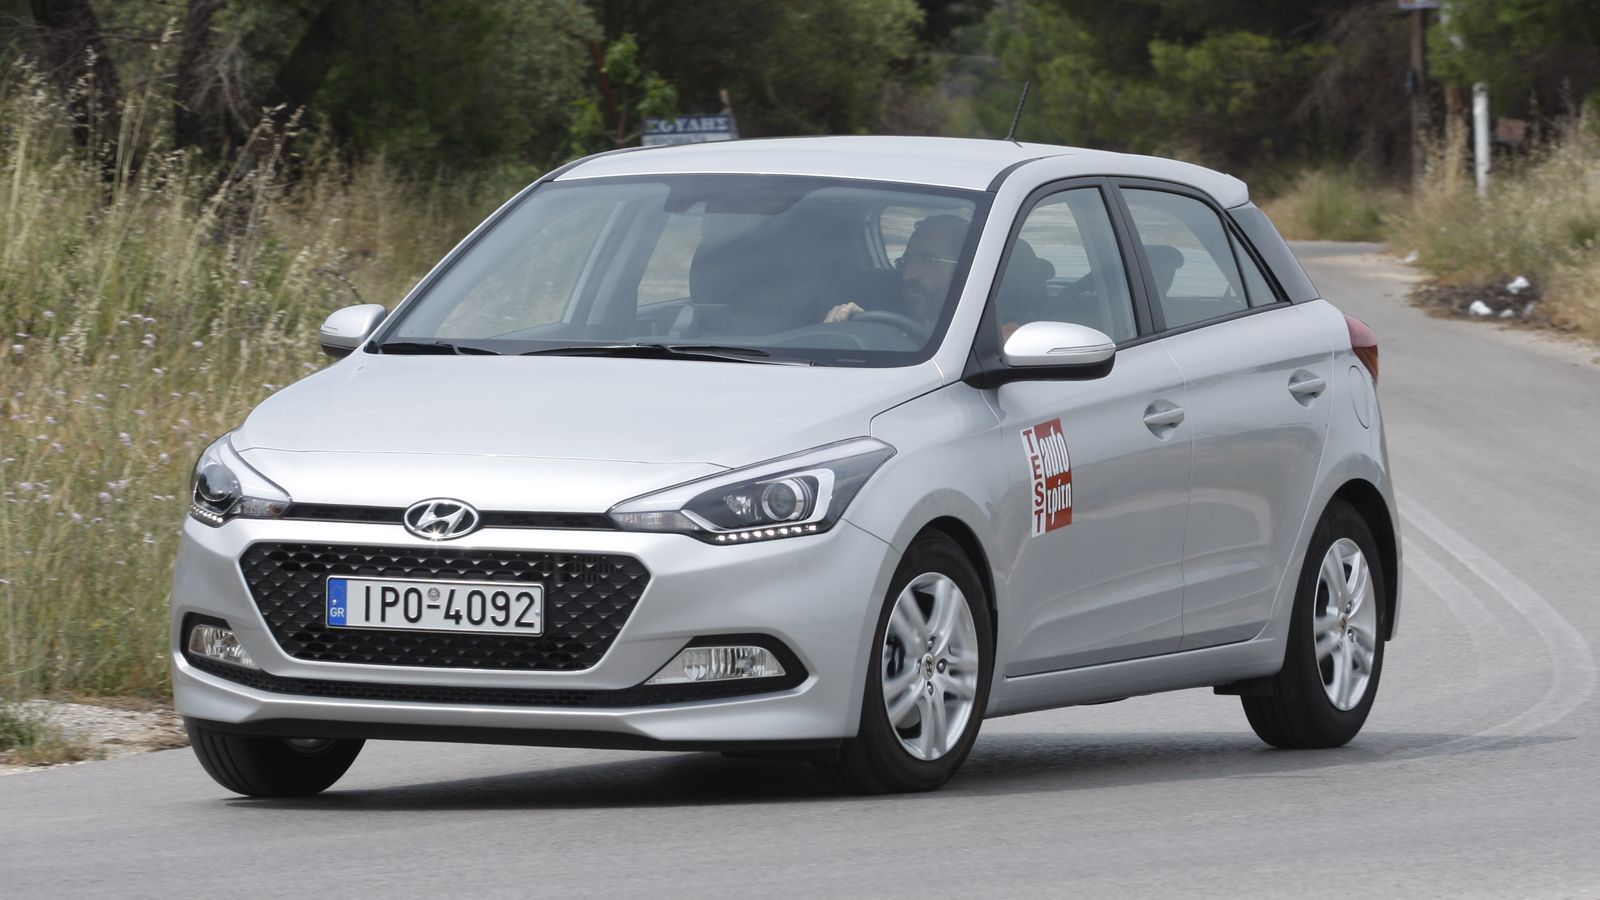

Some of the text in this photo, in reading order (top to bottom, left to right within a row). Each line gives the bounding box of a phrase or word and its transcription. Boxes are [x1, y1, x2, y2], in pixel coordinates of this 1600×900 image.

[1039, 425, 1070, 478] auto
[1022, 429, 1045, 533] TEST
[330, 607, 345, 618] GR
